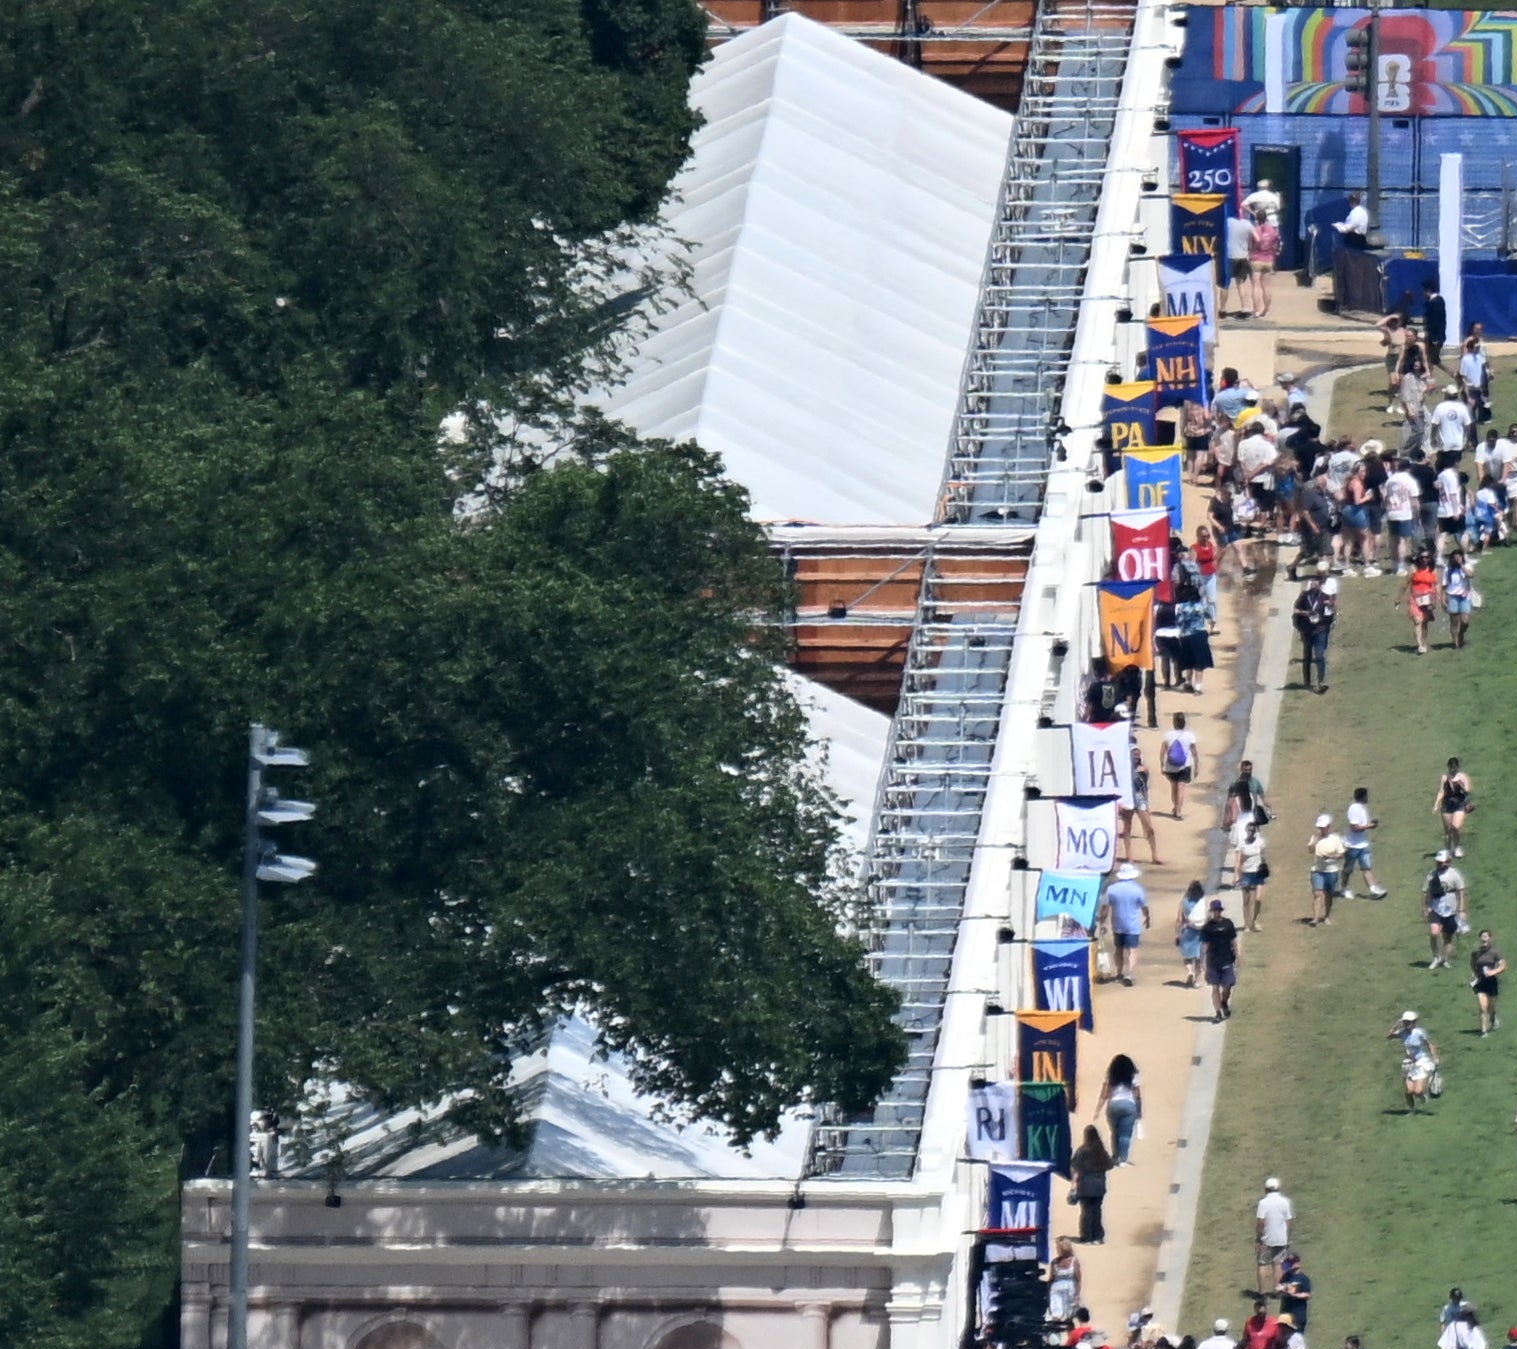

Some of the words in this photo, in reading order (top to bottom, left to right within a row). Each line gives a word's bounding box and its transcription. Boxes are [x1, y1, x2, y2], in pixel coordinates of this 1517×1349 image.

[1189, 169, 1231, 192] 250
[1182, 236, 1217, 255] NY
[1167, 292, 1208, 325] MA
[1157, 357, 1196, 389] NH
[1111, 422, 1145, 456] PA
[1118, 548, 1163, 581] OH
[1110, 622, 1143, 657] NJ
[1088, 750, 1119, 788] IA
[1067, 827, 1109, 859] MO
[1046, 885, 1087, 907] MN
[1043, 976, 1081, 1011] WI
[1033, 1052, 1062, 1082] IN
[1027, 1124, 1059, 1160] KY
[1000, 1200, 1037, 1229] MI
